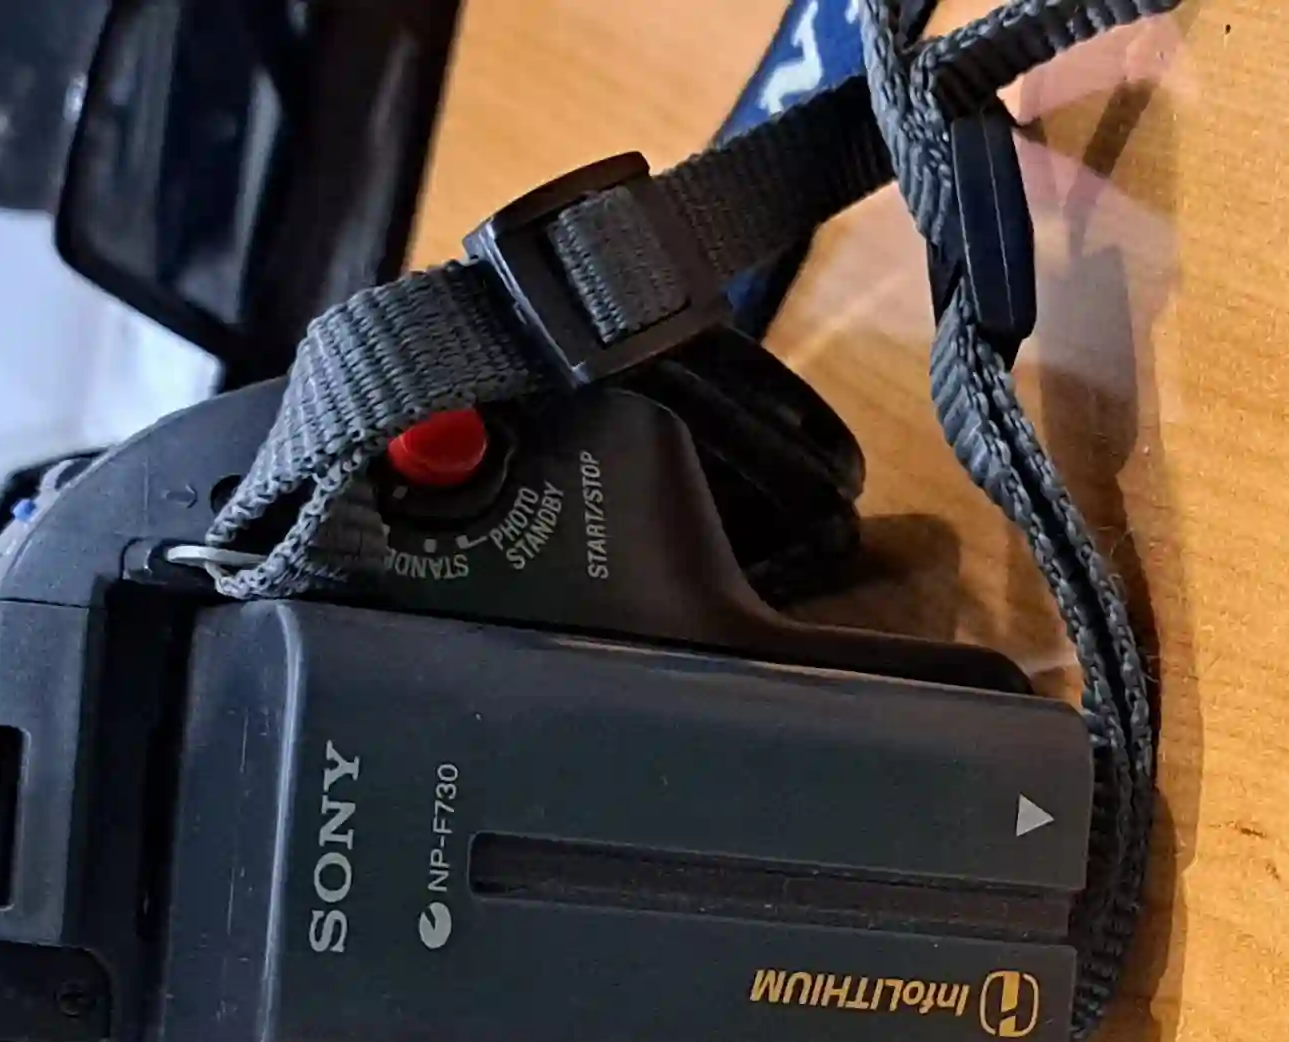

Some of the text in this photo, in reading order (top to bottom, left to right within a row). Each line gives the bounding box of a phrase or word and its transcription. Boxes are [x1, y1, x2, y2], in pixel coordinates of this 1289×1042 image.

[489, 486, 540, 550] PHOTO
[506, 479, 564, 570] STANDBY
[580, 450, 610, 579] START/STOP
[308, 739, 360, 953] SONY
[427, 762, 460, 892] NP-F730
[749, 969, 970, 1017] InfoLITHIUM
